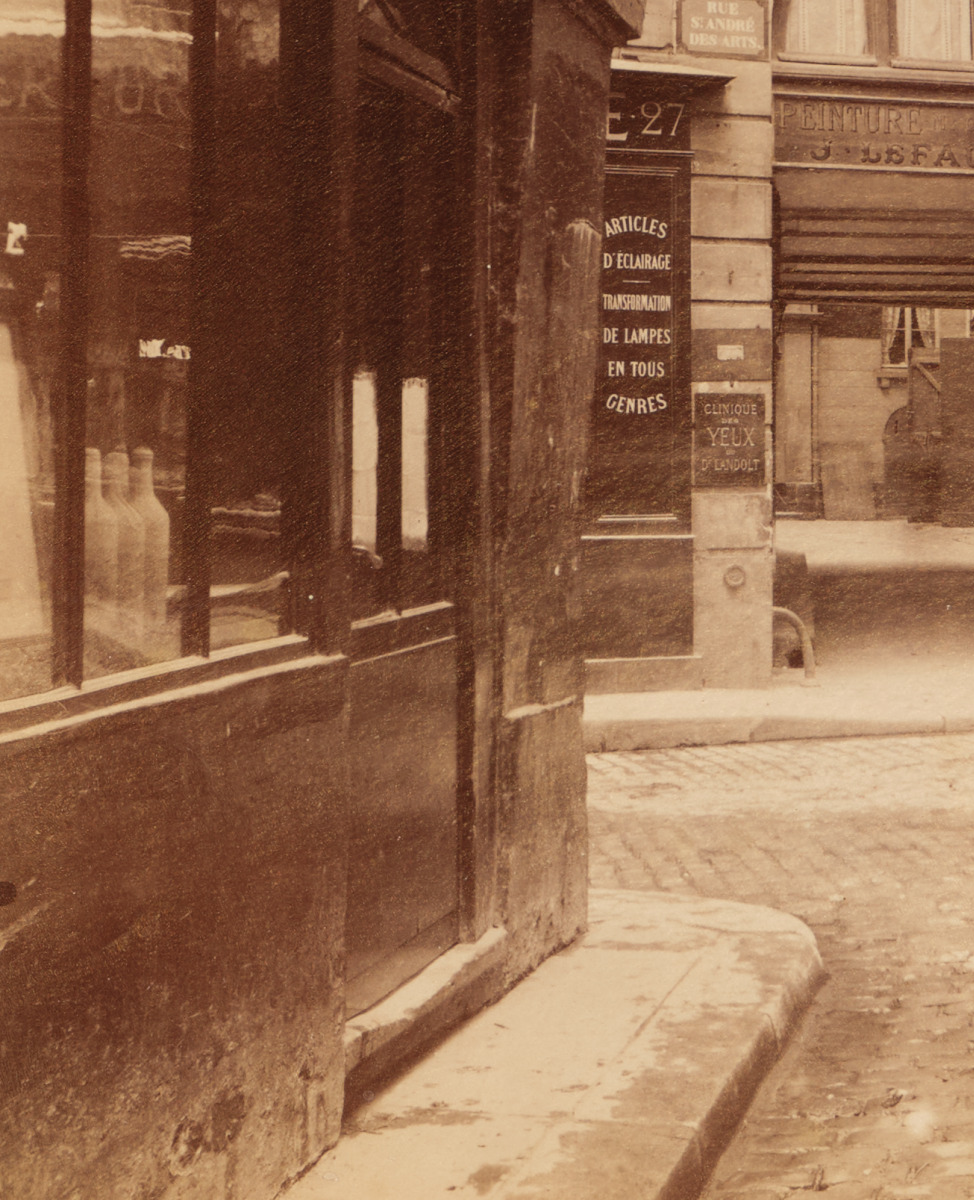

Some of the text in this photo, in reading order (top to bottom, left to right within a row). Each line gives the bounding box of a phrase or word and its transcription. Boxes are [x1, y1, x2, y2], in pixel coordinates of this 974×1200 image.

[707, 0, 739, 15] RUE
[706, 16, 755, 32] ANDRÉ
[689, 33, 718, 46] DES
[640, 101, 685, 136] 27
[779, 102, 922, 136] PEINTURE
[604, 215, 668, 239] ARTICLES
[603, 249, 672, 270] D'ÉCLAIRAGE
[603, 293, 672, 312] TRANSFORMATION
[603, 327, 671, 345] DE LAMPES
[608, 361, 665, 377] EN TOUS
[605, 393, 668, 415] GENRES
[704, 403, 758, 416] CLINIQUE
[706, 427, 755, 447] YEUX
[714, 458, 761, 471] LANDOLT
